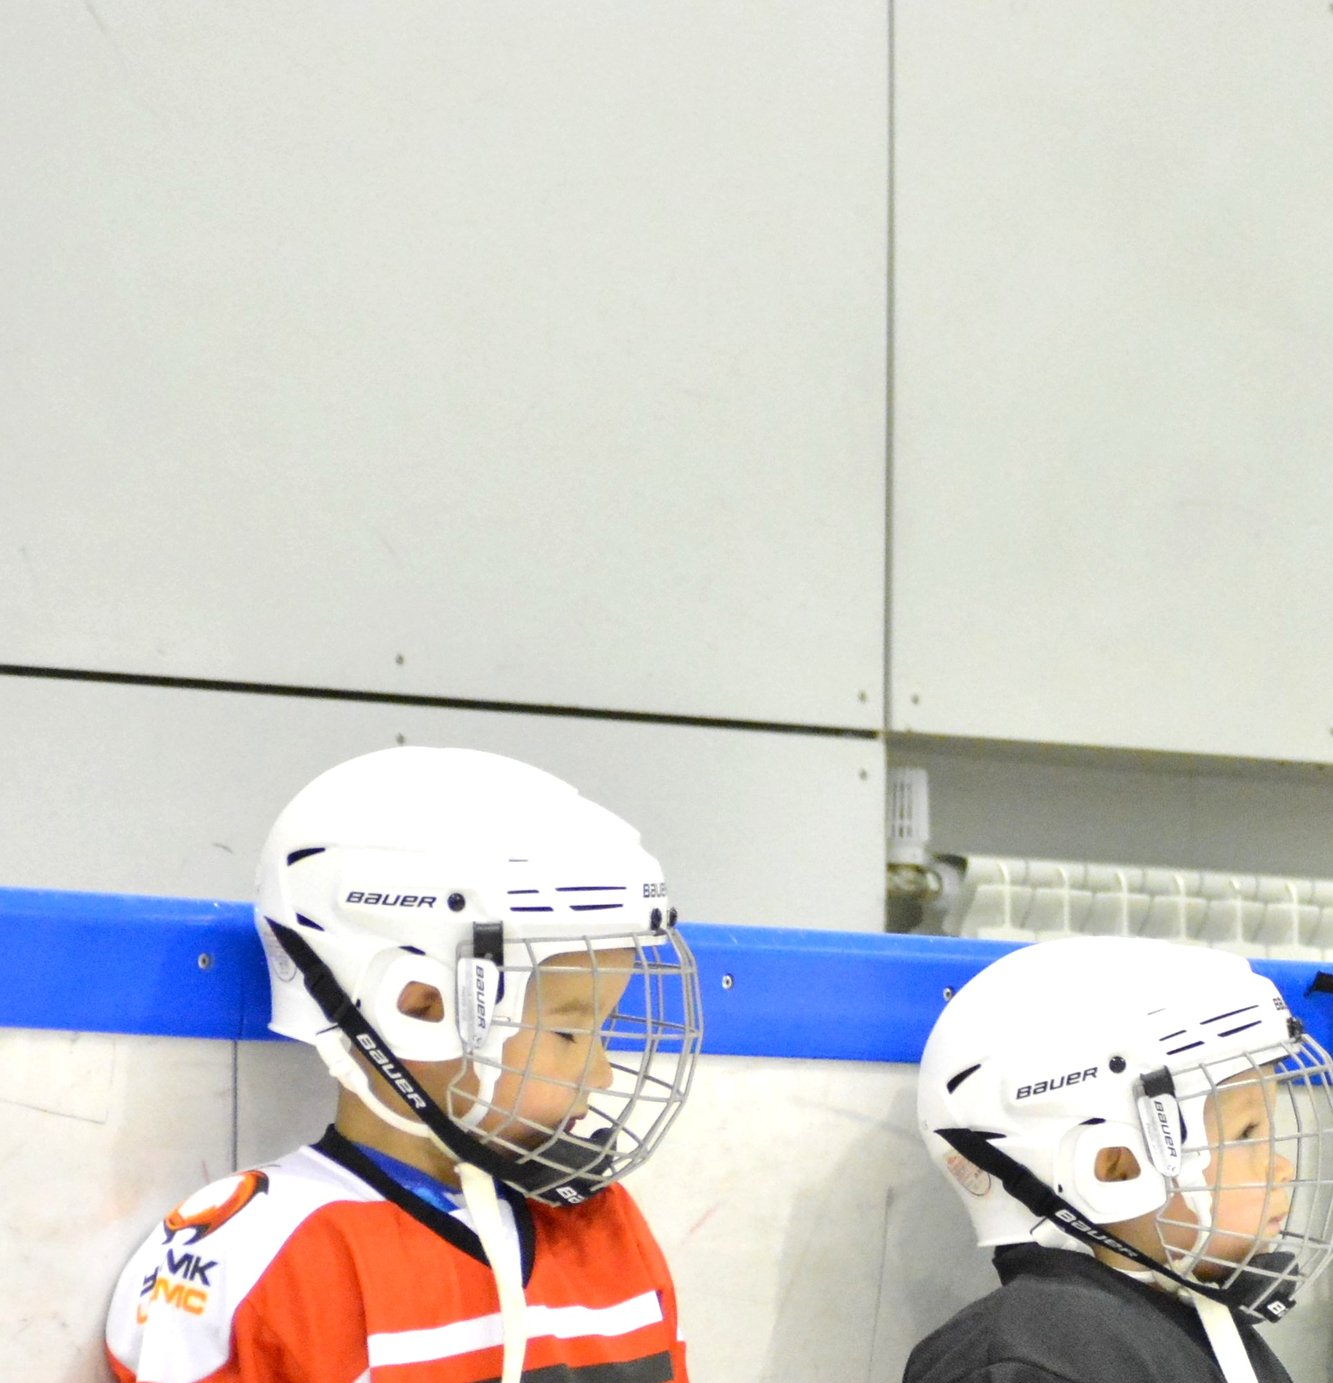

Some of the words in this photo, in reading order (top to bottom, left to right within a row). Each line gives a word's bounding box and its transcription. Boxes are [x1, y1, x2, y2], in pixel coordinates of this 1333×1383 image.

[346, 891, 437, 908] BAUER
[476, 966, 486, 1029] BAUER
[356, 1034, 427, 1110] BAUER
[1016, 1067, 1098, 1100] BAUER
[1154, 1101, 1177, 1158] BAUER
[1055, 1209, 1138, 1257] BAUER
